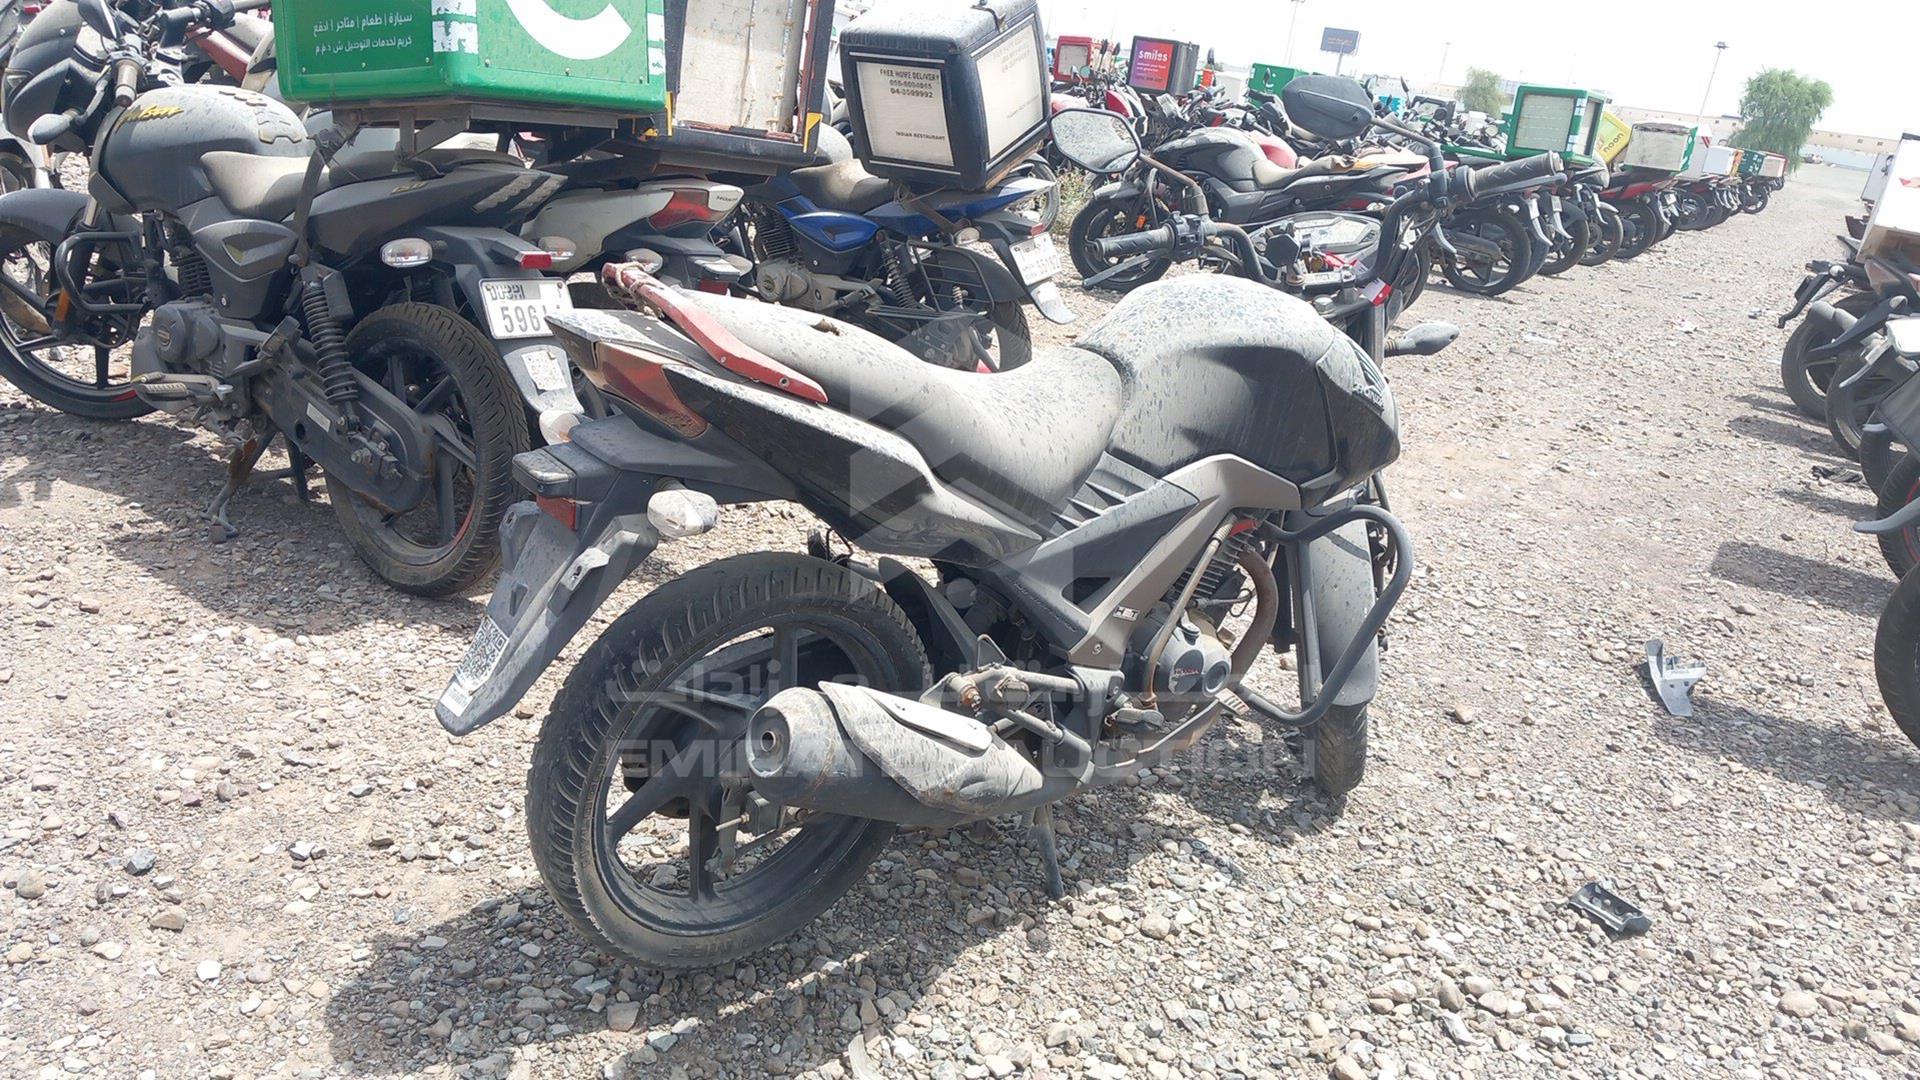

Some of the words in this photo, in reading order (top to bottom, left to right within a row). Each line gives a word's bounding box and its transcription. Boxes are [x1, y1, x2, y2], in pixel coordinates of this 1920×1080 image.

[1138, 49, 1168, 62] smiles
[880, 69, 894, 77] FREE
[912, 72, 939, 81] DELIVERY
[1603, 132, 1625, 153] noon
